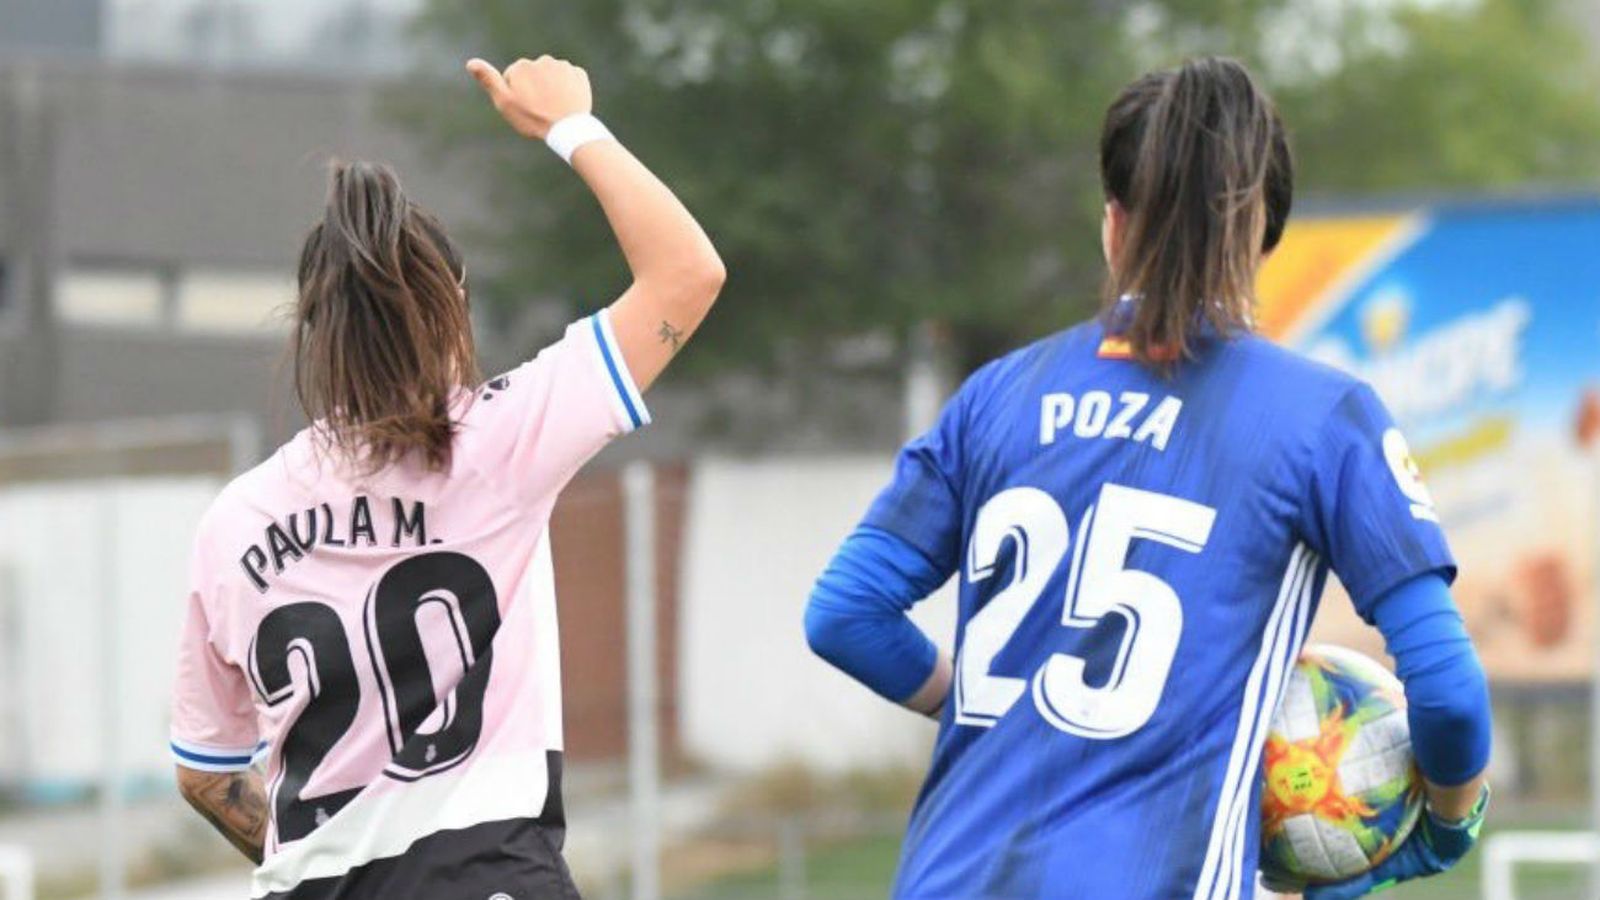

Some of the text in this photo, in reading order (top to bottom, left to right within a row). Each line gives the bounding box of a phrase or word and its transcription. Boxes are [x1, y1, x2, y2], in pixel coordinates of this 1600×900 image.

[1039, 390, 1184, 452] POZA
[239, 495, 444, 594] PAULA M.
[954, 482, 1217, 740] 25
[247, 551, 502, 854] 20
